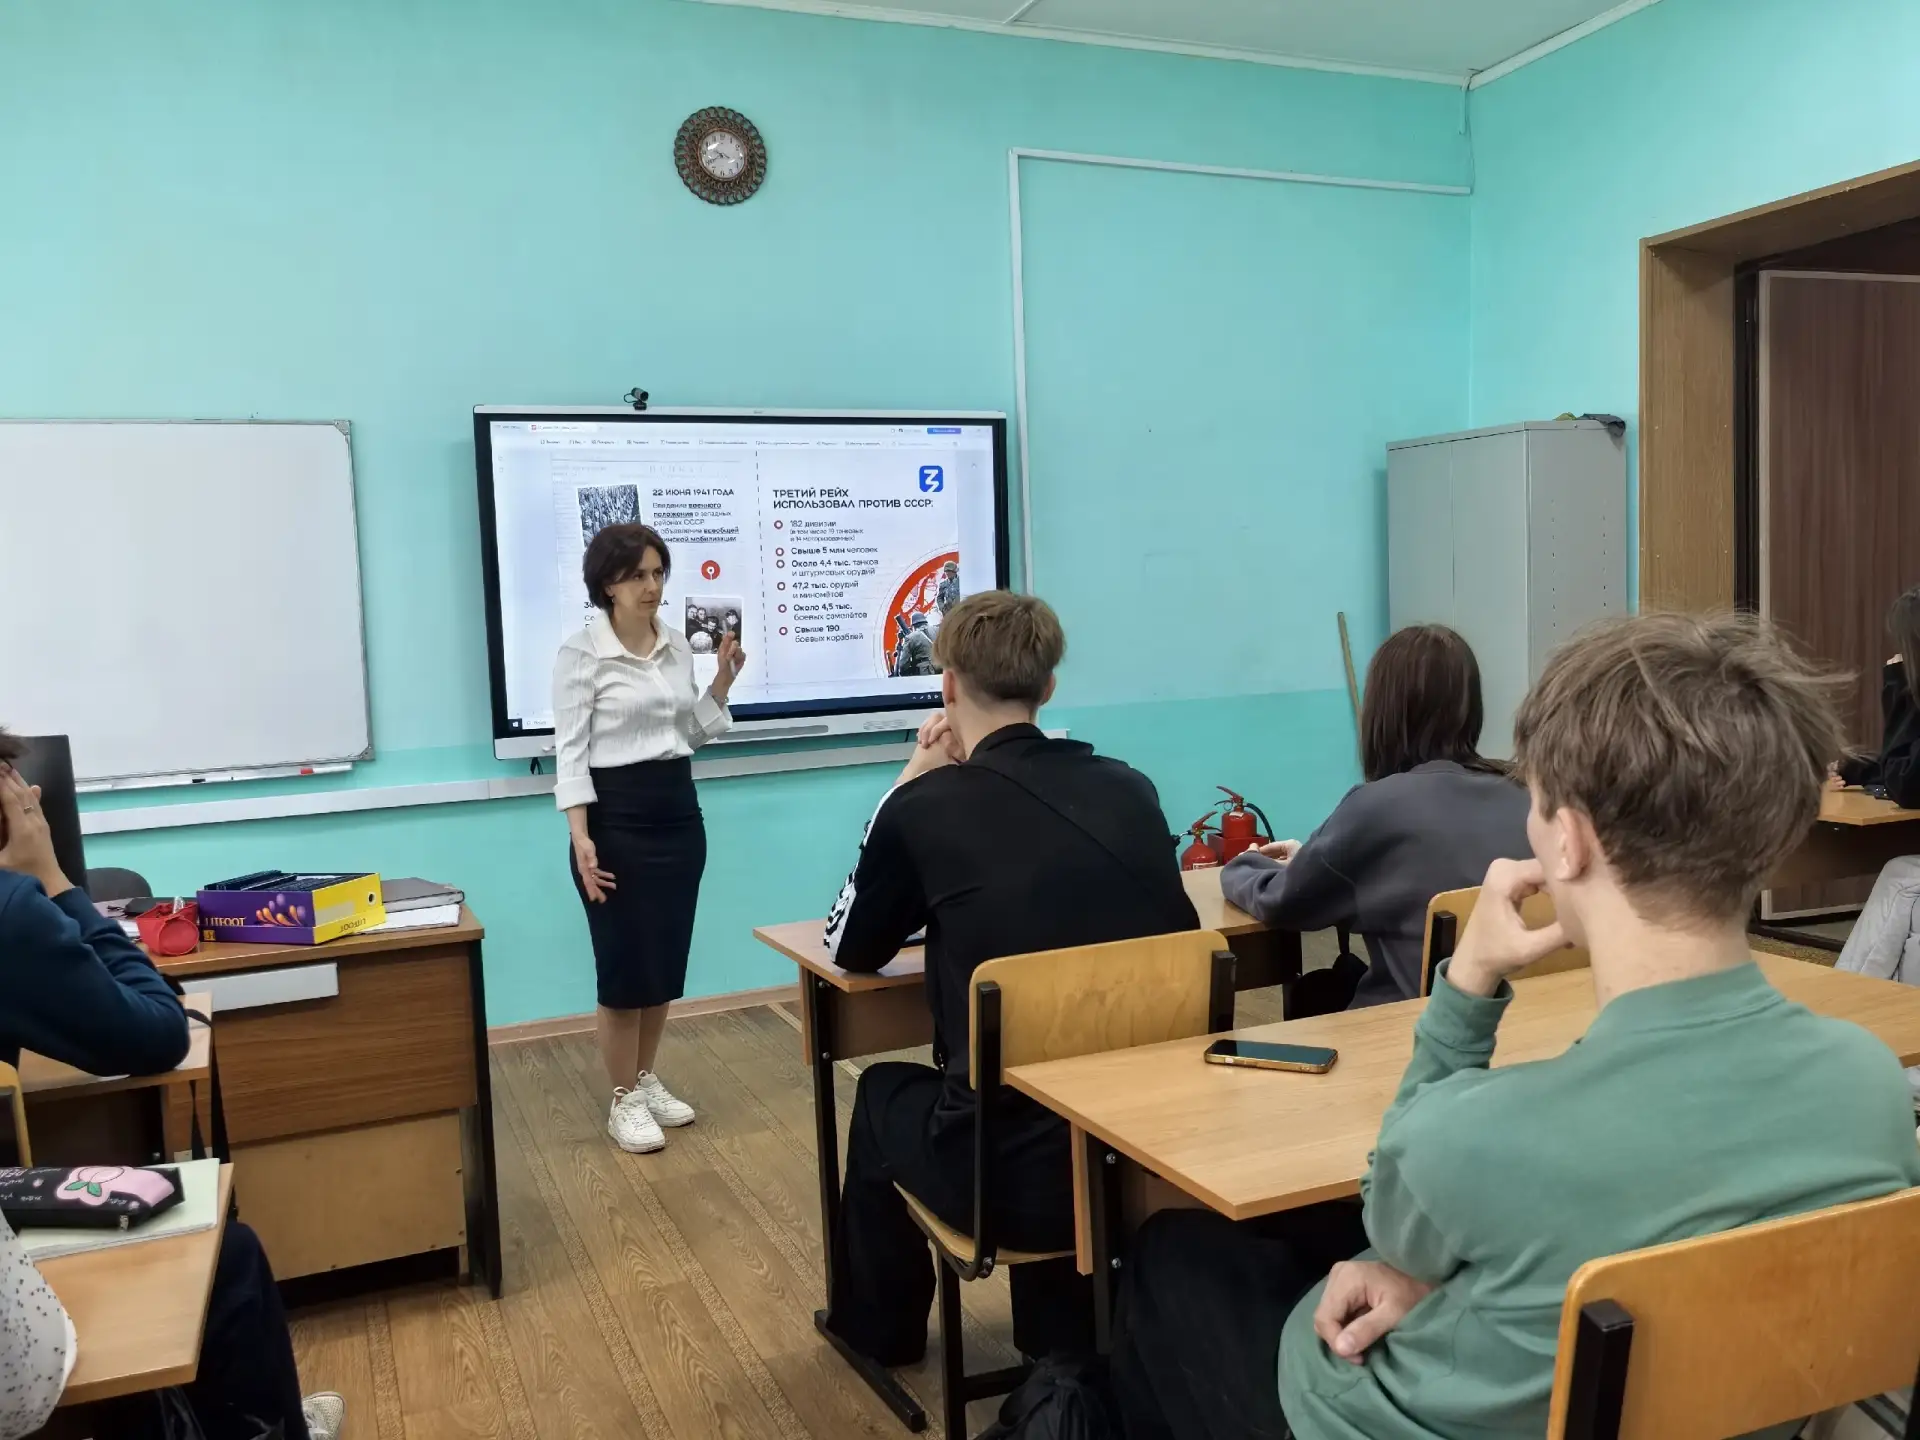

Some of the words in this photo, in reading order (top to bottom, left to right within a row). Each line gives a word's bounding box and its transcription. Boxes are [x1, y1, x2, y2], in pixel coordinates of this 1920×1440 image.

[773, 488, 816, 498] ТРЕТИЙ
[820, 487, 849, 497] РЕЙХ
[773, 500, 855, 509] ИСПОЛЬЗОВАЛ
[858, 499, 901, 508] ПРОТИВ
[904, 499, 934, 508] СССР:
[846, 568, 875, 576] орудий
[830, 581, 859, 589] орудий
[795, 635, 824, 643] боевых
